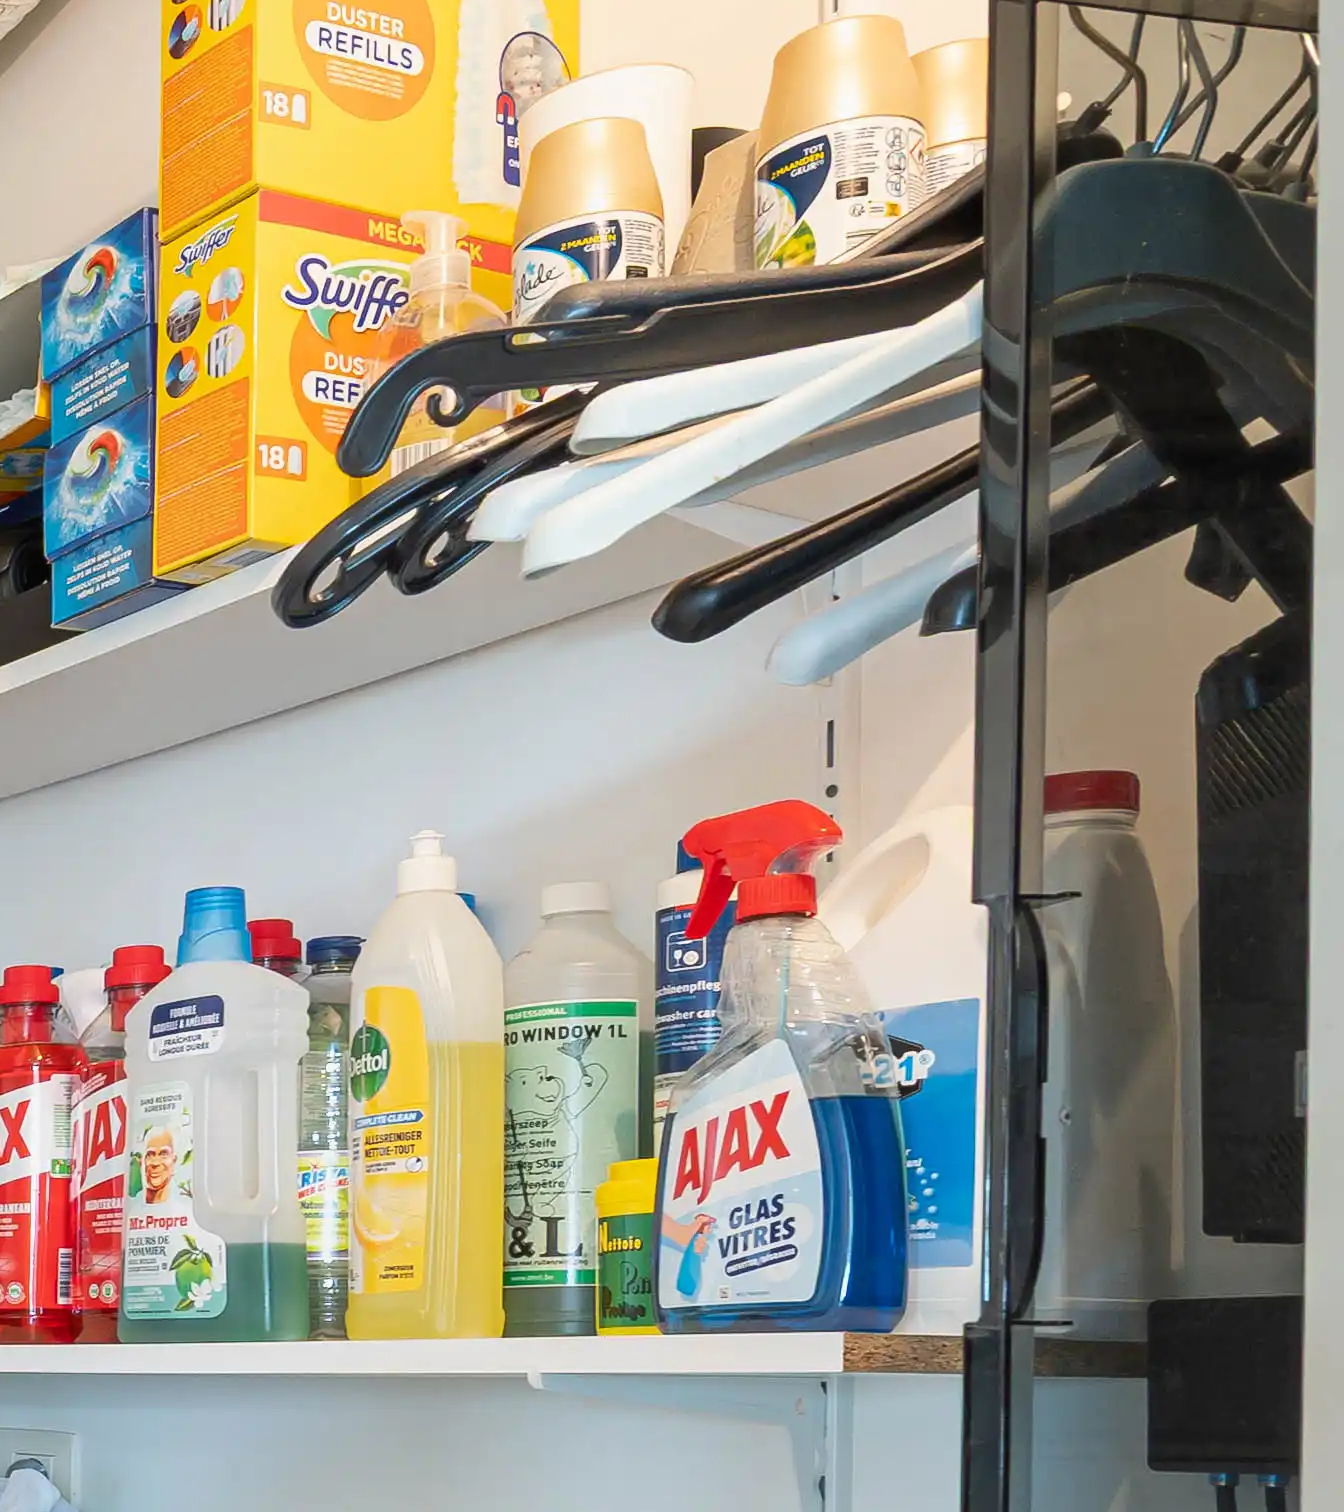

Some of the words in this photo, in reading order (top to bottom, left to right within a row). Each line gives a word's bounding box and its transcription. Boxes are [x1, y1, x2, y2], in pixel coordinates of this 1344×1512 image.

[327, 2, 404, 37] DUSTER
[318, 27, 413, 69] REFILLS
[263, 90, 289, 117] 18
[802, 143, 825, 156] TOT
[175, 225, 234, 274] Swiffer
[368, 219, 425, 249] MEGA
[285, 258, 409, 328] Swiffe
[258, 444, 285, 470] 18
[522, 1024, 603, 1043] WINDOW
[608, 1024, 628, 1039] 1L
[348, 1049, 388, 1077] Dettol
[365, 1131, 422, 1145] ALLESREINIGER
[365, 1144, 415, 1157] NETTOIE-TOUT
[672, 1090, 791, 1204] AJAX
[729, 1193, 784, 1229] GLAS
[598, 1221, 642, 1254] Nettoie
[718, 1217, 796, 1259] VITRES
